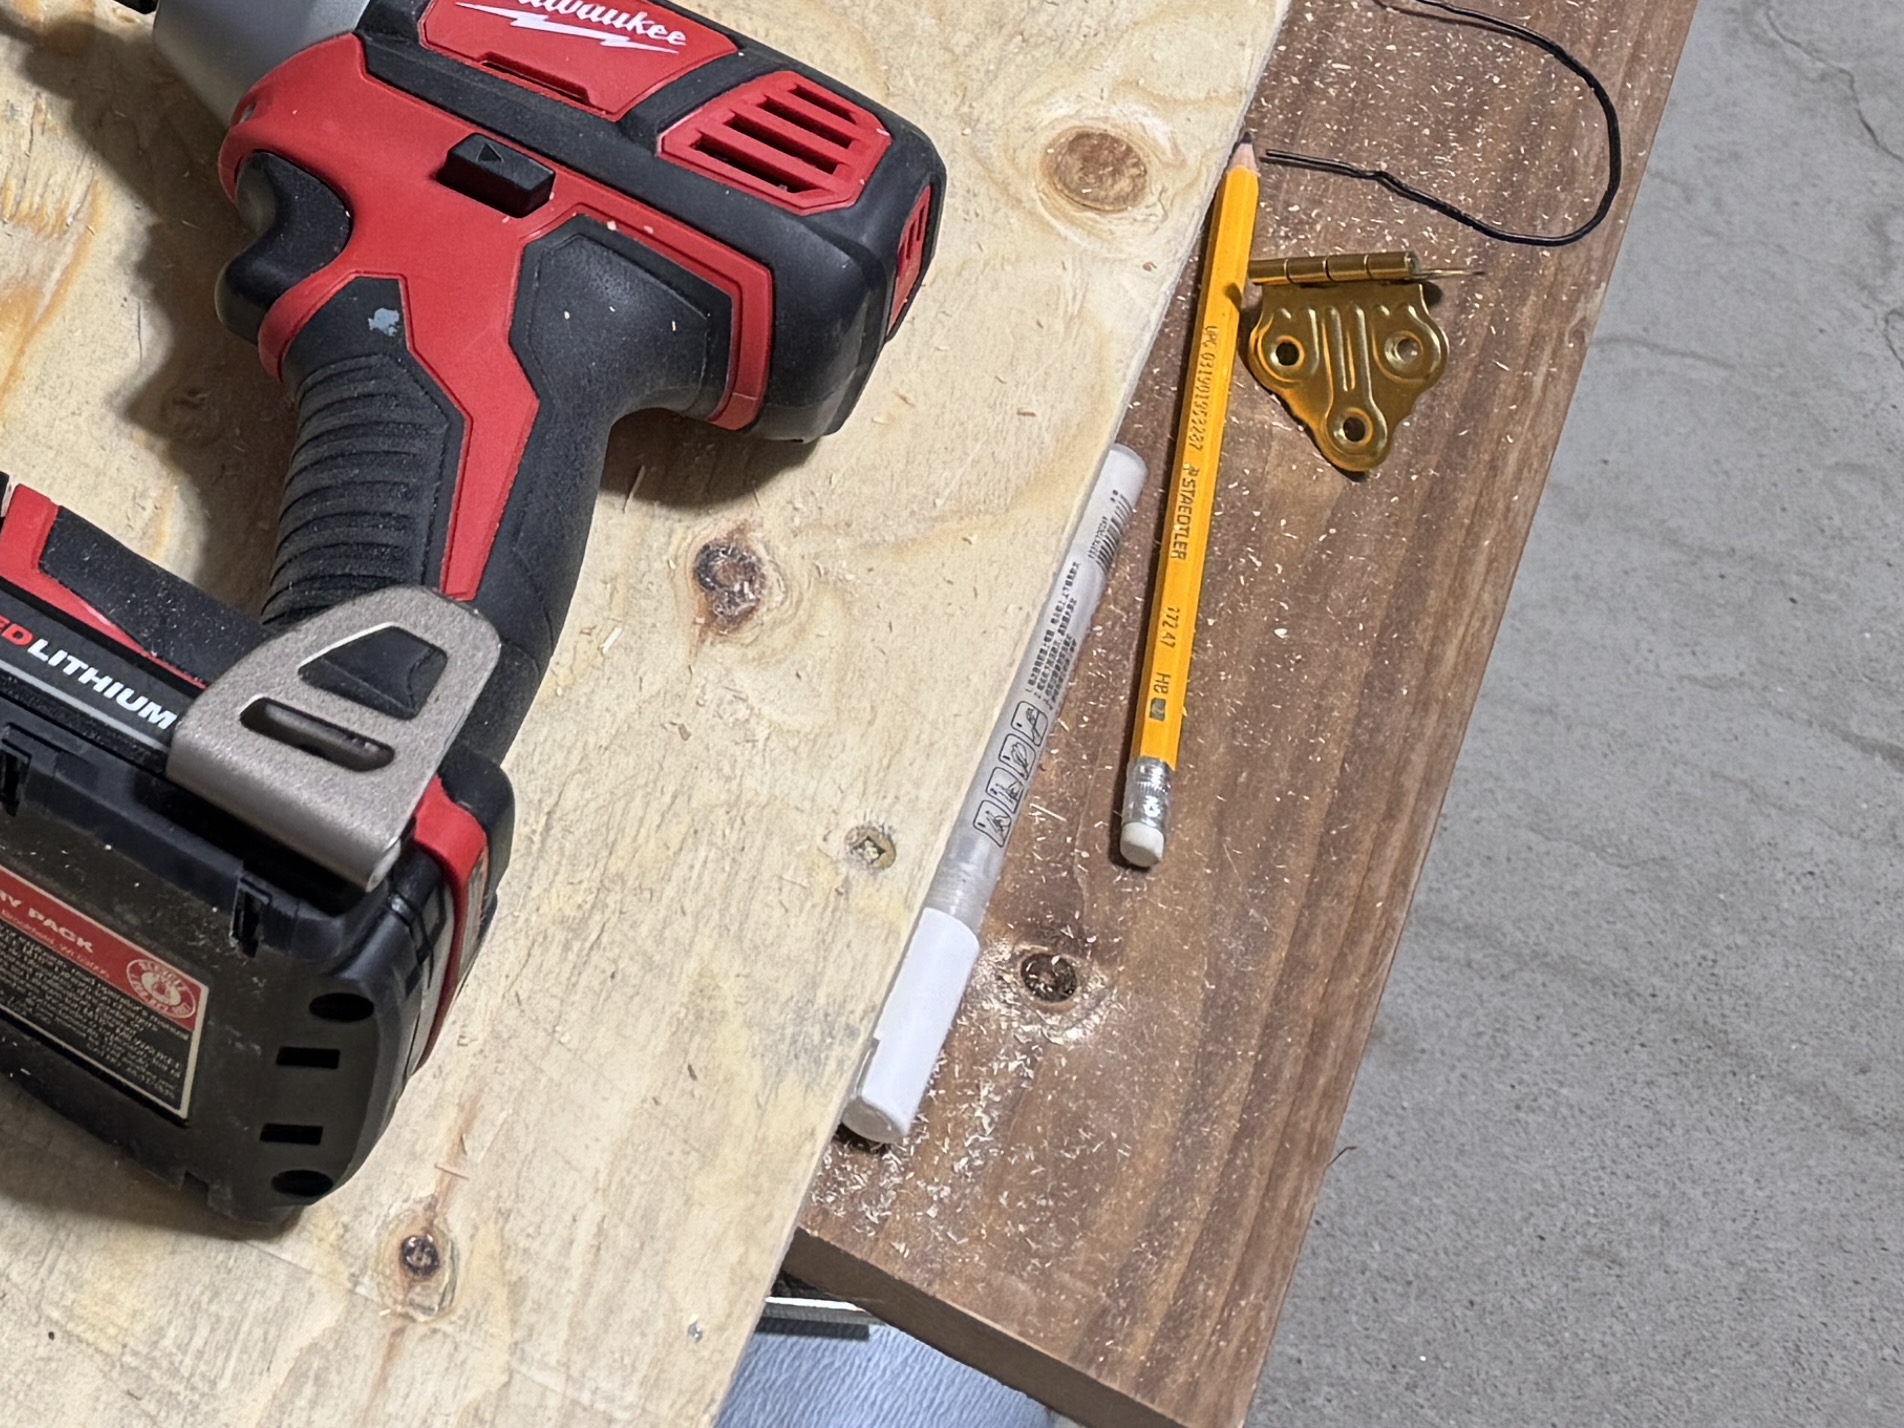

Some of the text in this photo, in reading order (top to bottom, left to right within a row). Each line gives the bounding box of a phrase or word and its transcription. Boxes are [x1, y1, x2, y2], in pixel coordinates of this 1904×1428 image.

[1202, 324, 1217, 347] UPC
[1171, 477, 1195, 560] STAEDTLER
[1153, 672, 1169, 694] HB
[25, 906, 96, 954] PACK
